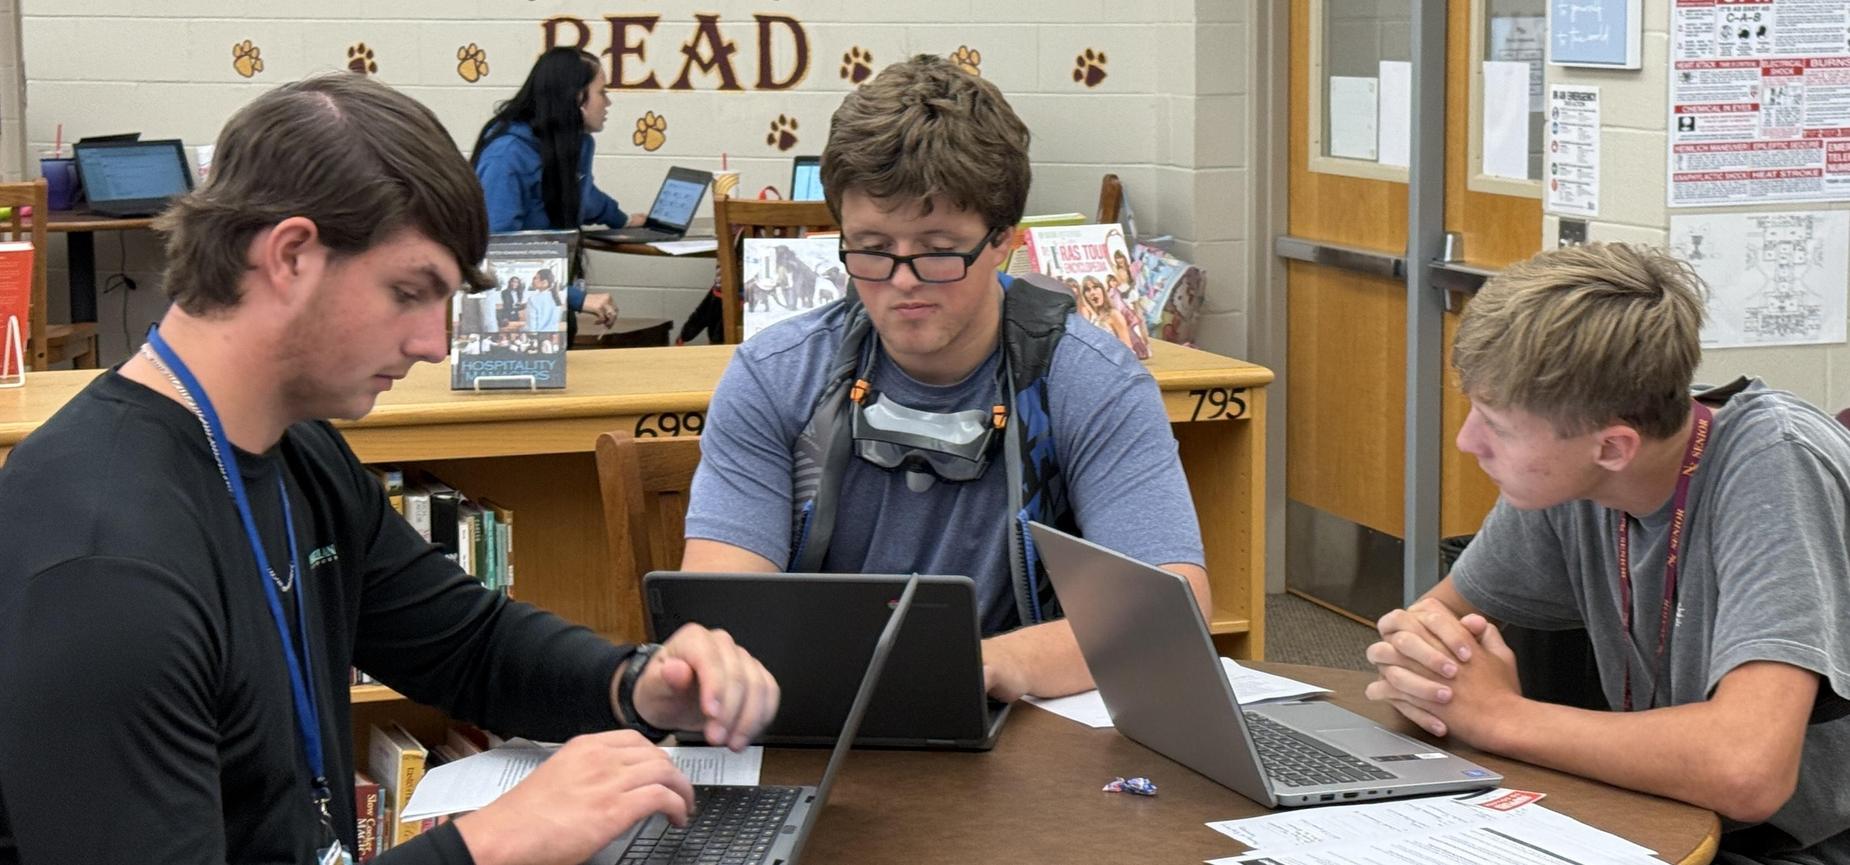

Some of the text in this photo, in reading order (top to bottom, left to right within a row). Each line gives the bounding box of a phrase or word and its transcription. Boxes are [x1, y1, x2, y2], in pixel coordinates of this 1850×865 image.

[461, 359, 556, 371] HOSPITALITY
[1189, 387, 1246, 422] 795
[634, 411, 706, 438] 699
[1692, 418, 1709, 459] SENIOR
[1670, 508, 1685, 550] SENIOR
[366, 793, 377, 817] Slow
[365, 818, 377, 852] Cooker
